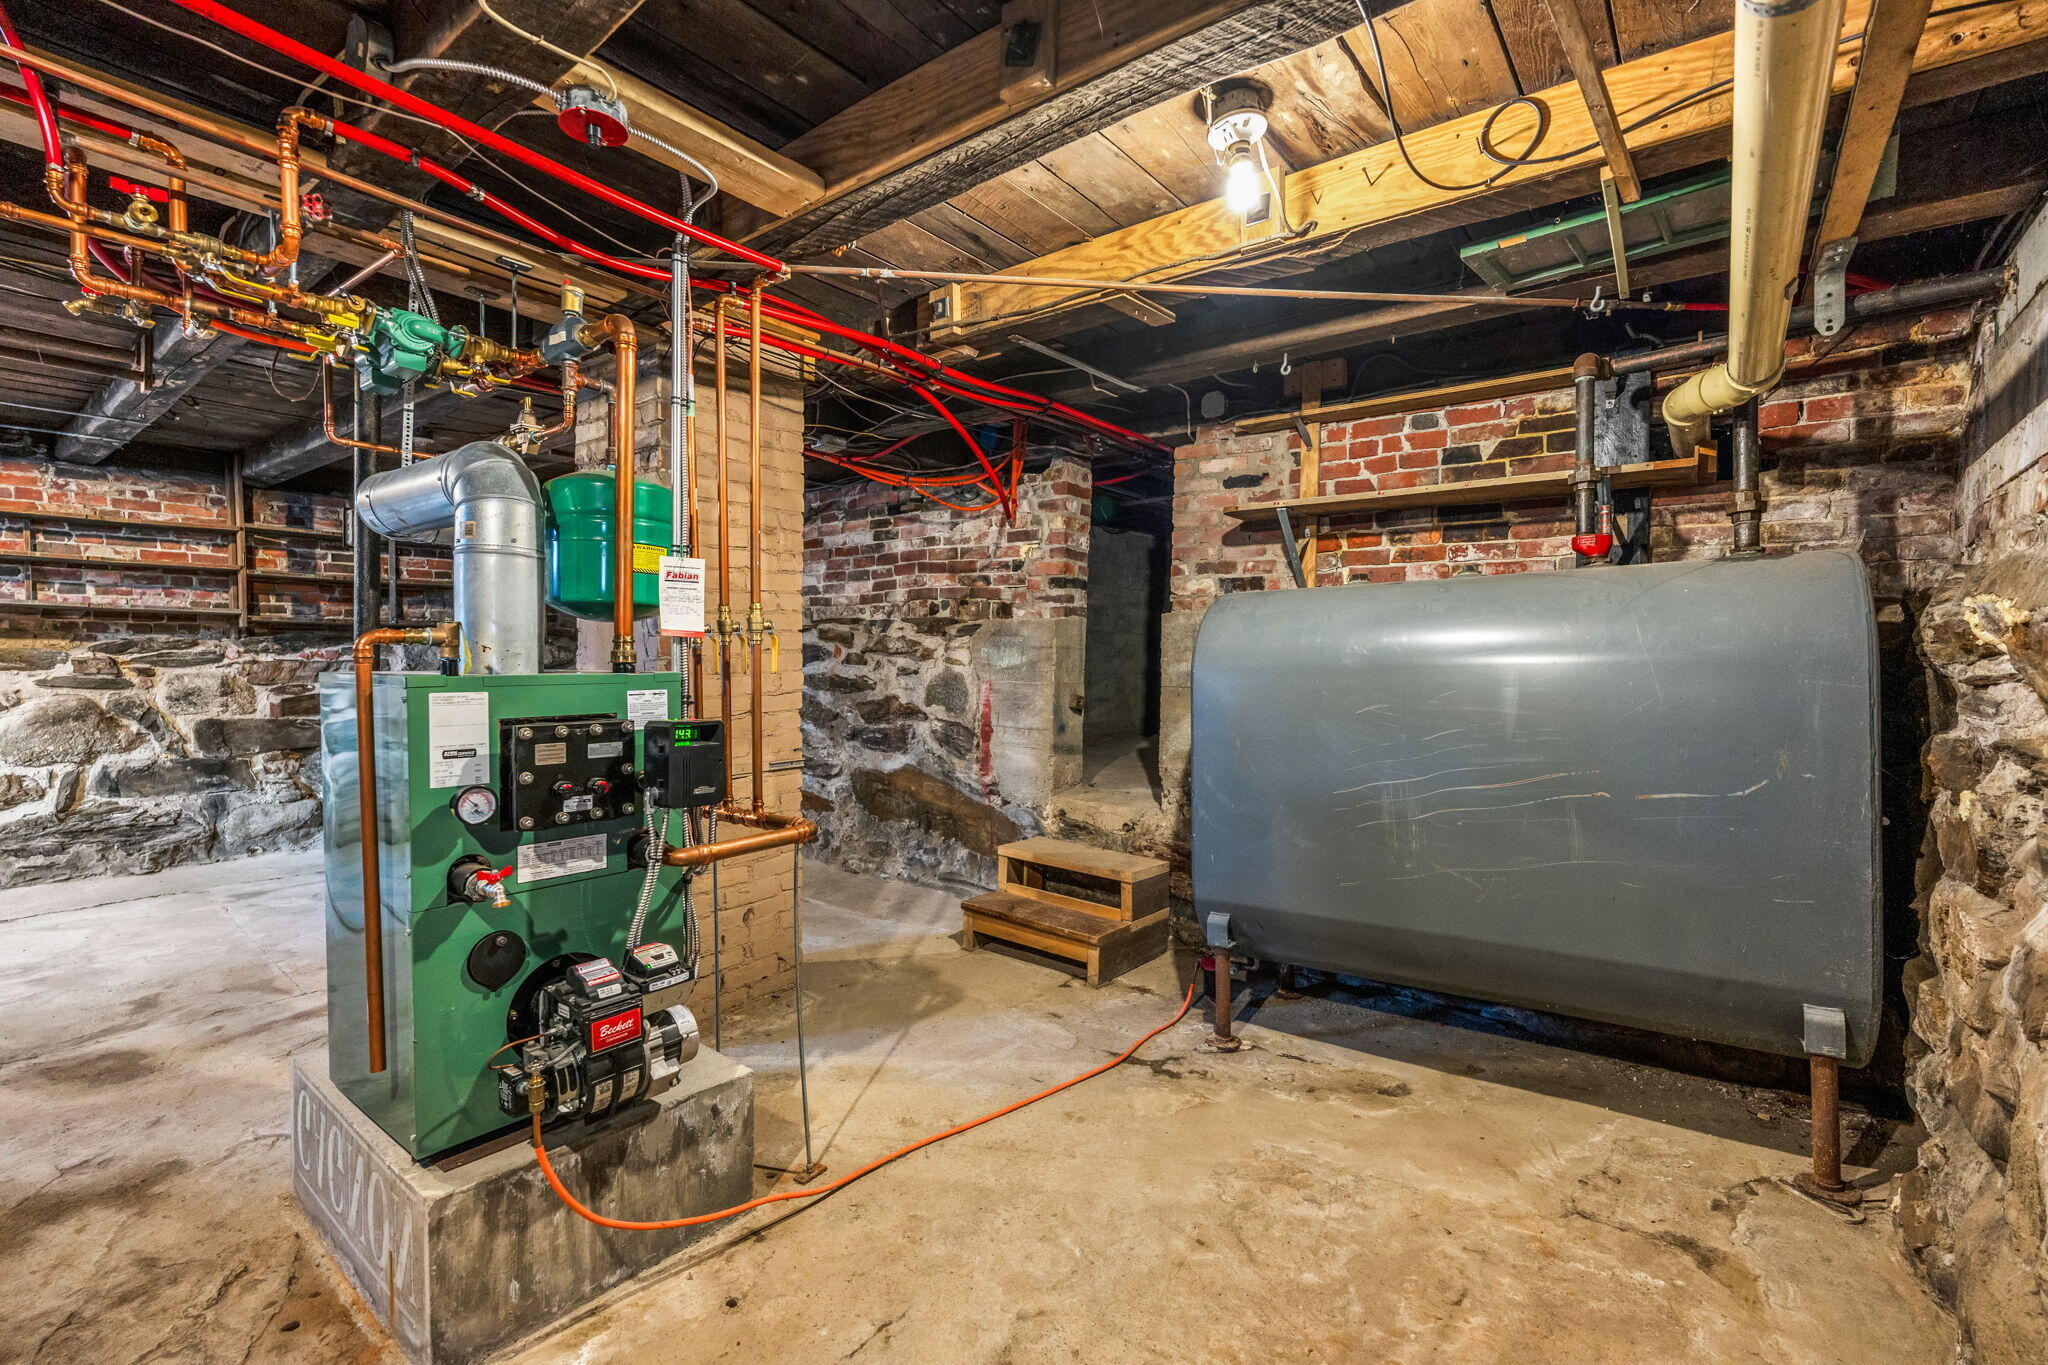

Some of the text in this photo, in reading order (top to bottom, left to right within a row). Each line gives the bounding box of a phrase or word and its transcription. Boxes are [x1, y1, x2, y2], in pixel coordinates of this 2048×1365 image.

[665, 571, 699, 580] Fabian
[675, 729, 691, 739] 143
[600, 1018, 634, 1037] Beckett
